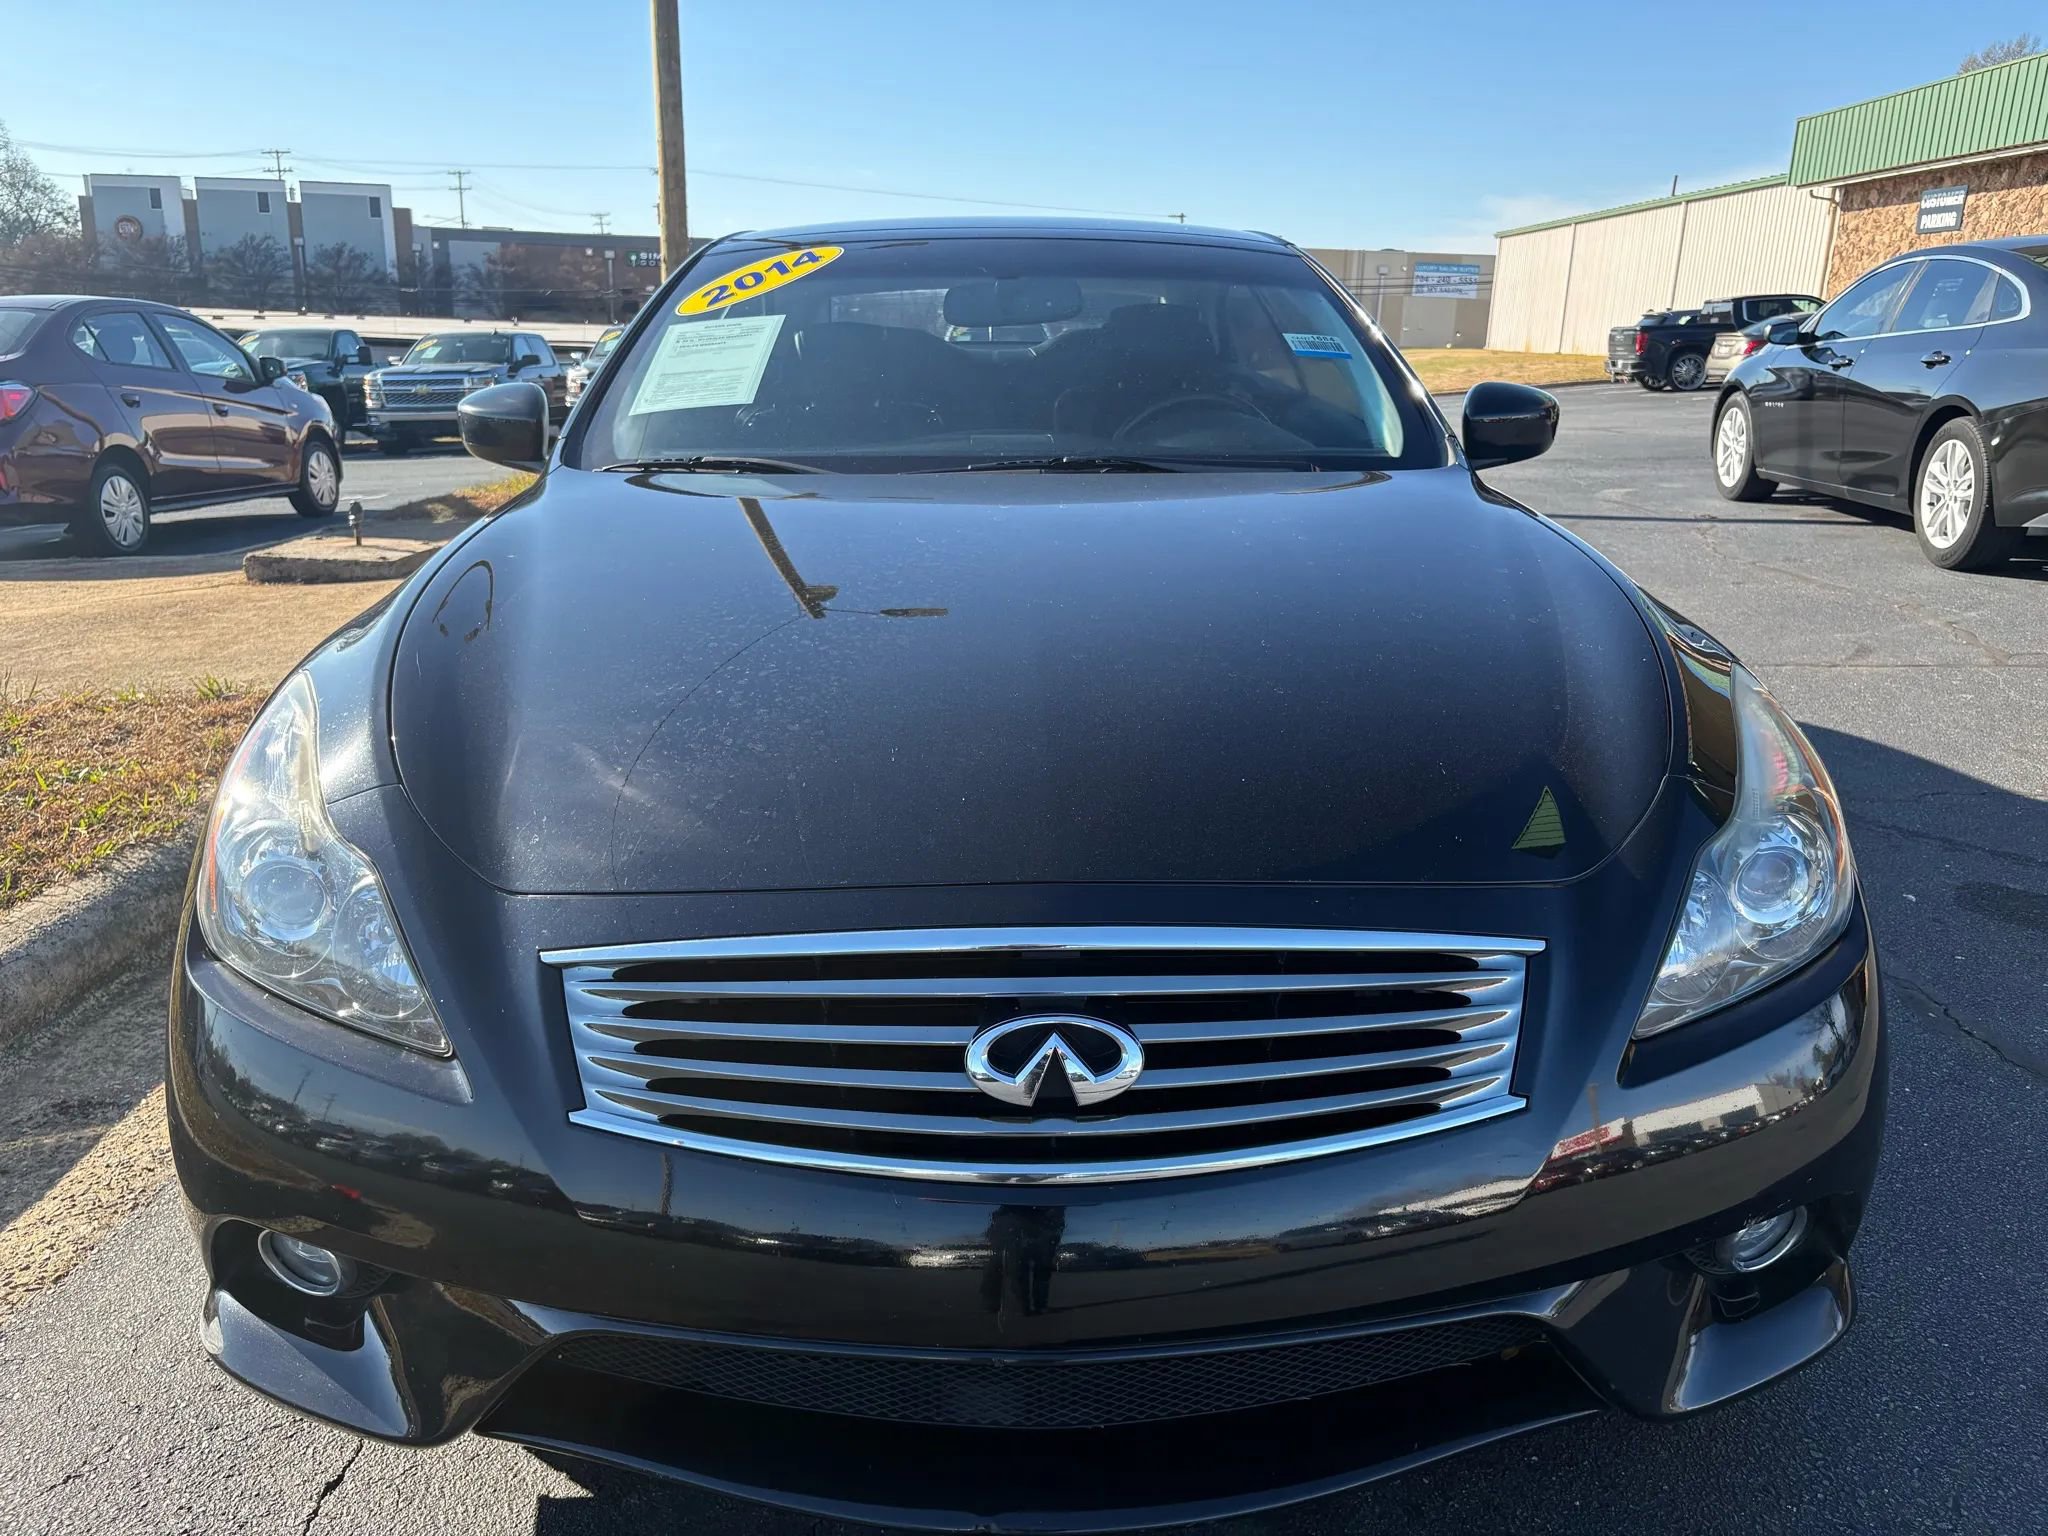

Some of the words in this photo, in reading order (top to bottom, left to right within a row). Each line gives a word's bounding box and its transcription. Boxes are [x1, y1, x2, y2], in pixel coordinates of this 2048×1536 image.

[1921, 190, 1965, 209] CUSTOMER
[1920, 211, 1957, 229] PARKING
[701, 250, 825, 308] 2014
